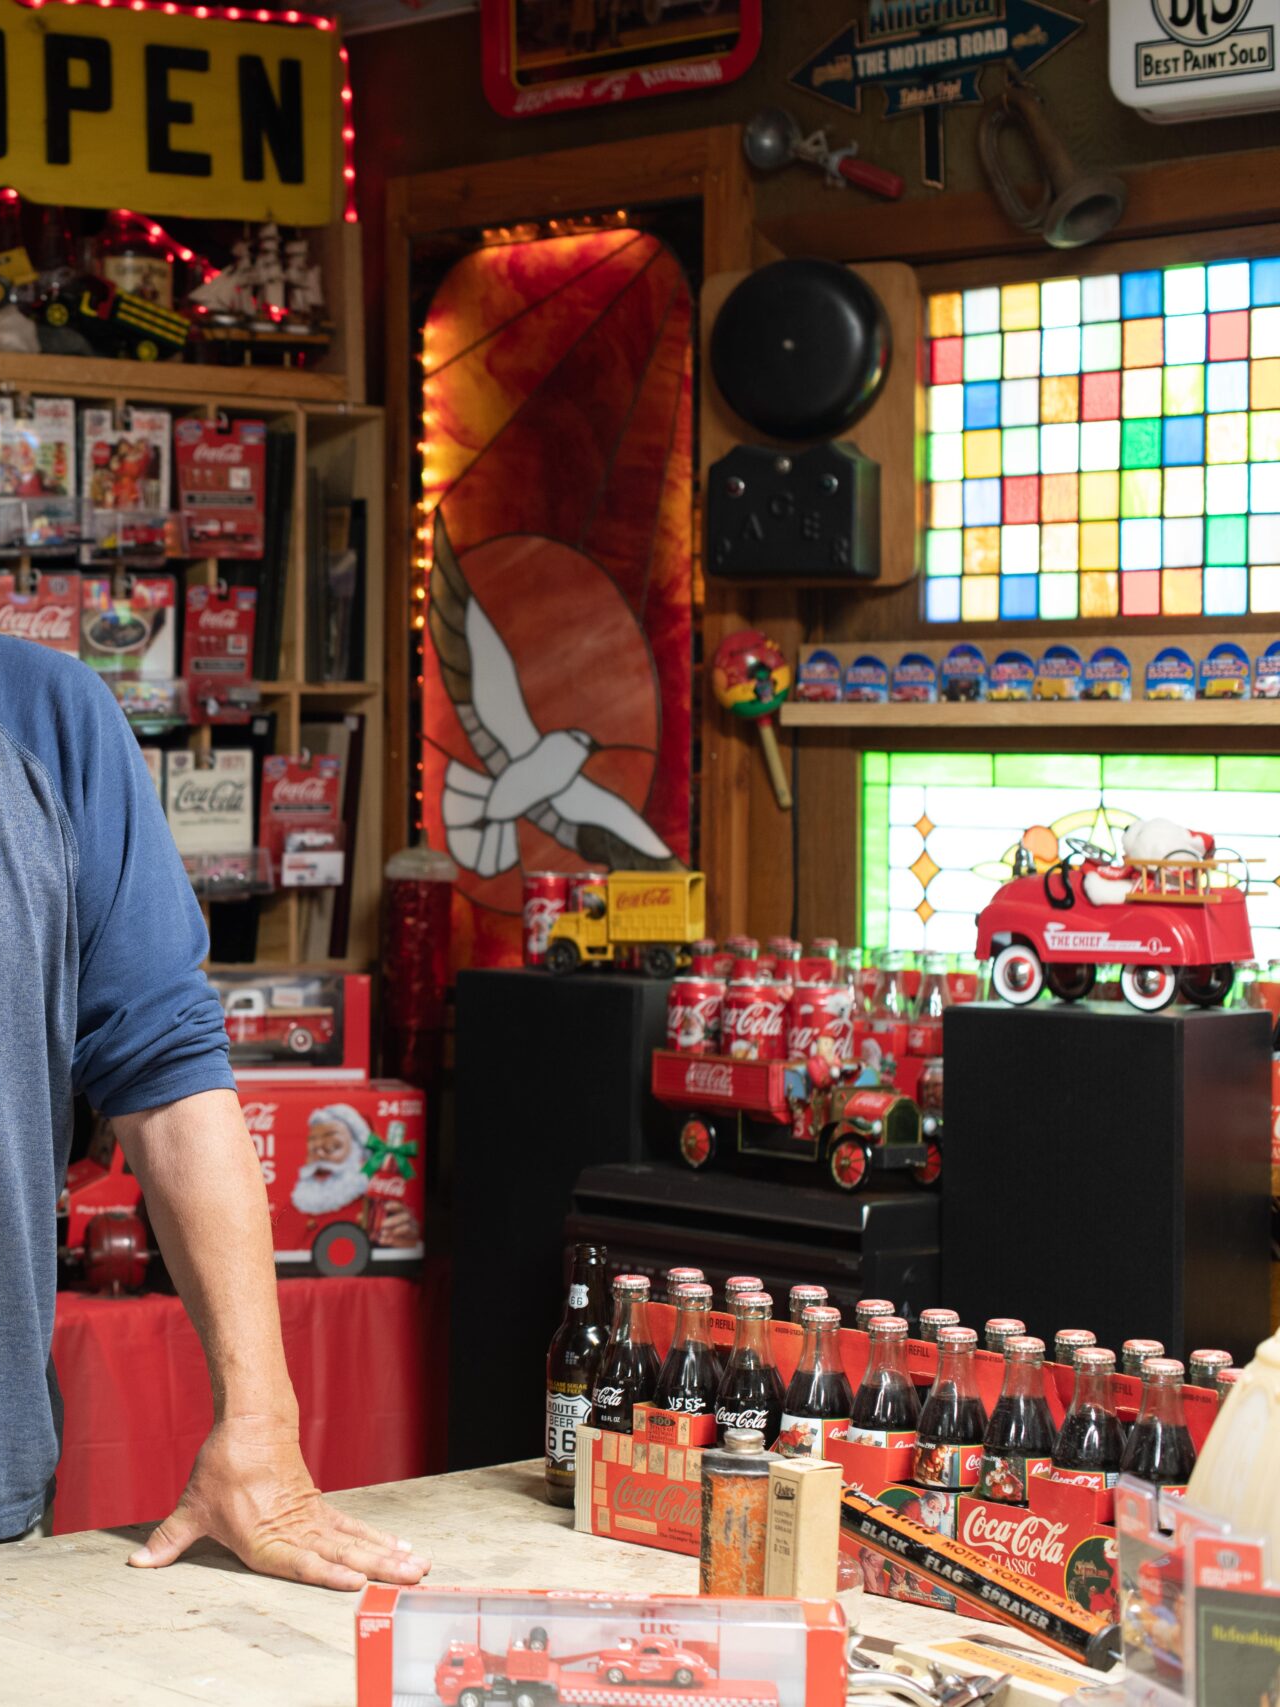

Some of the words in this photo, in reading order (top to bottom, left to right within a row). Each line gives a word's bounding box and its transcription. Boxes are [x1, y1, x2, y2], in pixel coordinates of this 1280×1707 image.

[855, 50, 888, 77] THE
[888, 36, 958, 71] MOTHER
[959, 27, 1008, 58] ROAD
[1143, 54, 1180, 77] BEST
[1183, 48, 1227, 72] PAINT
[1229, 42, 1267, 66] SOLD
[174, 778, 246, 813] Coca-Cola
[272, 778, 327, 801] Coca-Cola
[617, 888, 673, 911] Coca-Cola
[1051, 935, 1070, 947] THE
[1072, 935, 1103, 947] CHIEF
[685, 1062, 733, 1088] Coca-Cola
[377, 1099, 400, 1117] 24
[570, 1296, 583, 1306] 66
[716, 1318, 735, 1331] REFILL
[548, 1401, 579, 1415] ROUTE
[715, 1405, 770, 1430] Coca-Cola
[549, 1415, 574, 1428] BEER
[548, 1427, 576, 1453] 66
[613, 1475, 702, 1528] Coca-Cola
[774, 1481, 795, 1498] Oster
[962, 1505, 1069, 1566] Coca-Cola
[859, 1520, 909, 1556] BLACK
[922, 1554, 964, 1584] FLAG
[979, 1584, 1050, 1631] SPRAYER
[988, 1553, 1037, 1577] CLASSIC
